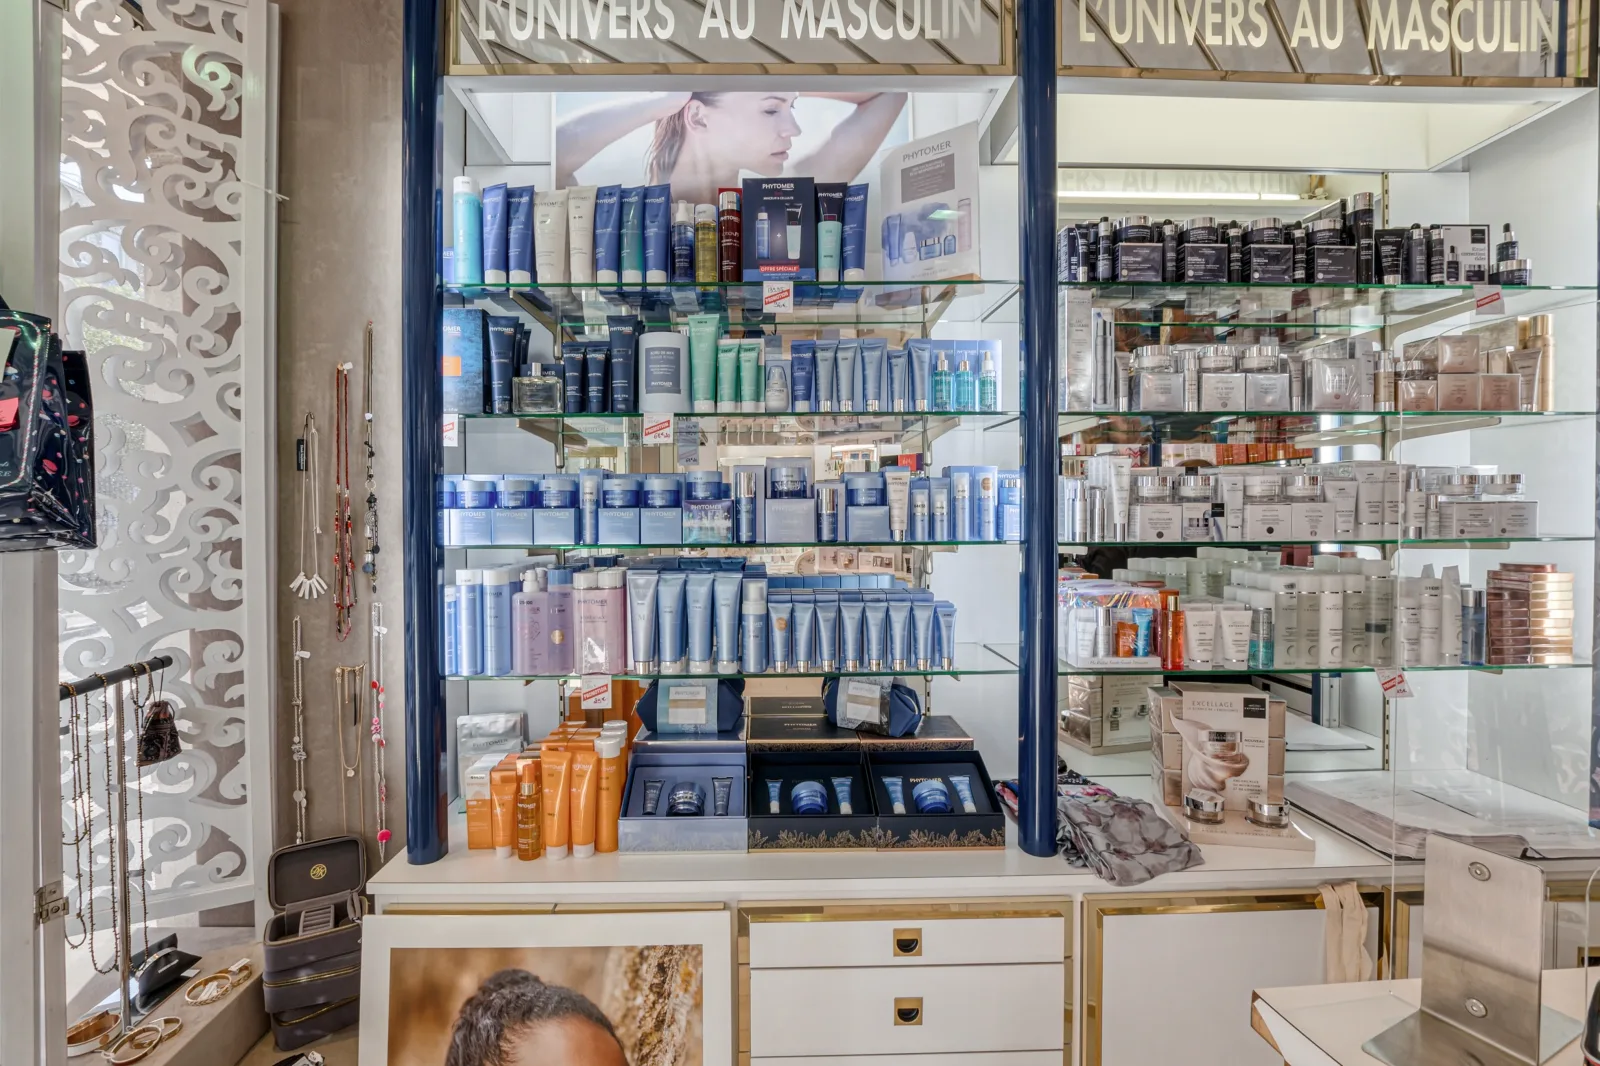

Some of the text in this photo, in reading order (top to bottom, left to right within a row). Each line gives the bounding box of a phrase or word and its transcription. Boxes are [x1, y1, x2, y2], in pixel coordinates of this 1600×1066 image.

[699, 0, 757, 40] AU
[780, 0, 982, 41] MASCULIN
[1080, 0, 1559, 53] L'UNIVERS AU MASCULIN
[902, 140, 952, 162] PHYTOMER
[646, 420, 670, 436] PROMOTION
[583, 685, 608, 700] PROMOTION
